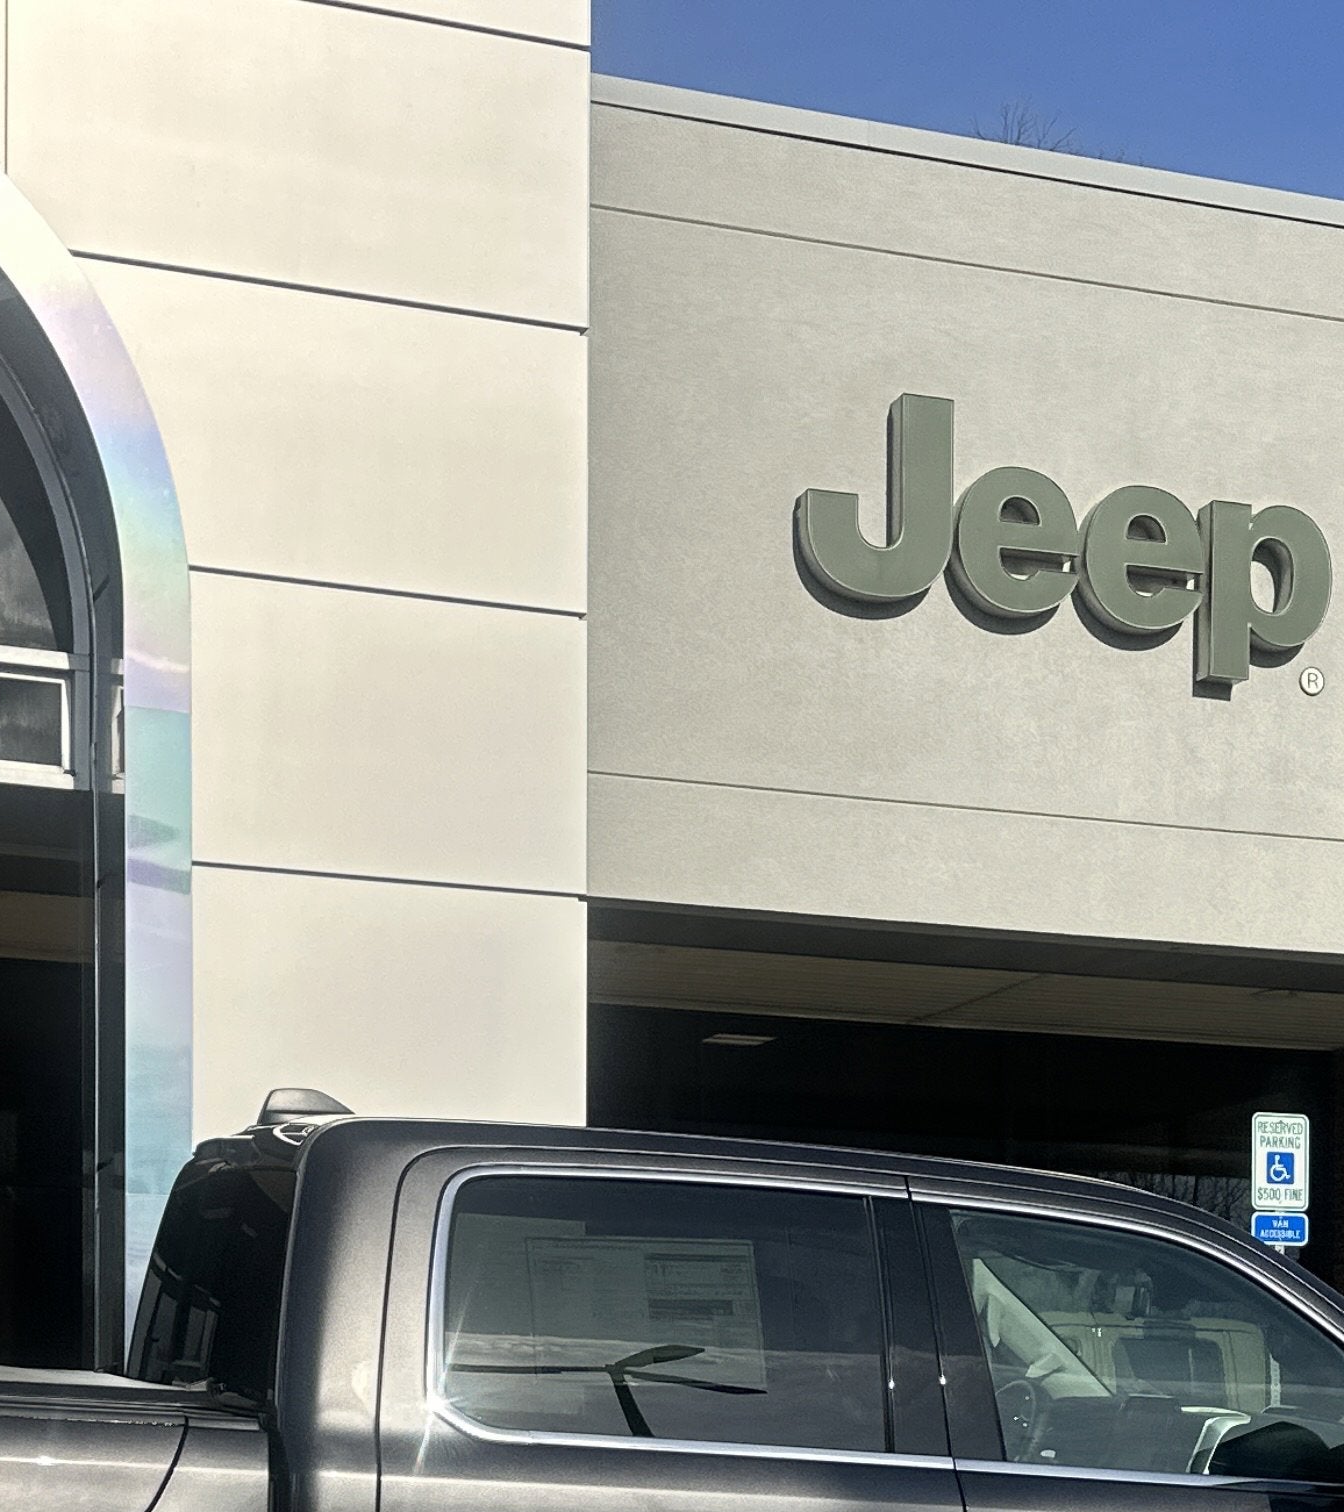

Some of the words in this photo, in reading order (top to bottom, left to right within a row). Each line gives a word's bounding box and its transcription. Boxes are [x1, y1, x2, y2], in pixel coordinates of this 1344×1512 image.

[794, 393, 1332, 690] Jeep
[1257, 1121, 1303, 1135] RESERVED
[1259, 1136, 1301, 1149] PARKING
[1257, 1187, 1281, 1201] $500
[1284, 1188, 1303, 1201] FINE
[1271, 1219, 1289, 1228] VAN
[1259, 1229, 1301, 1239] ACCESSIBLE
